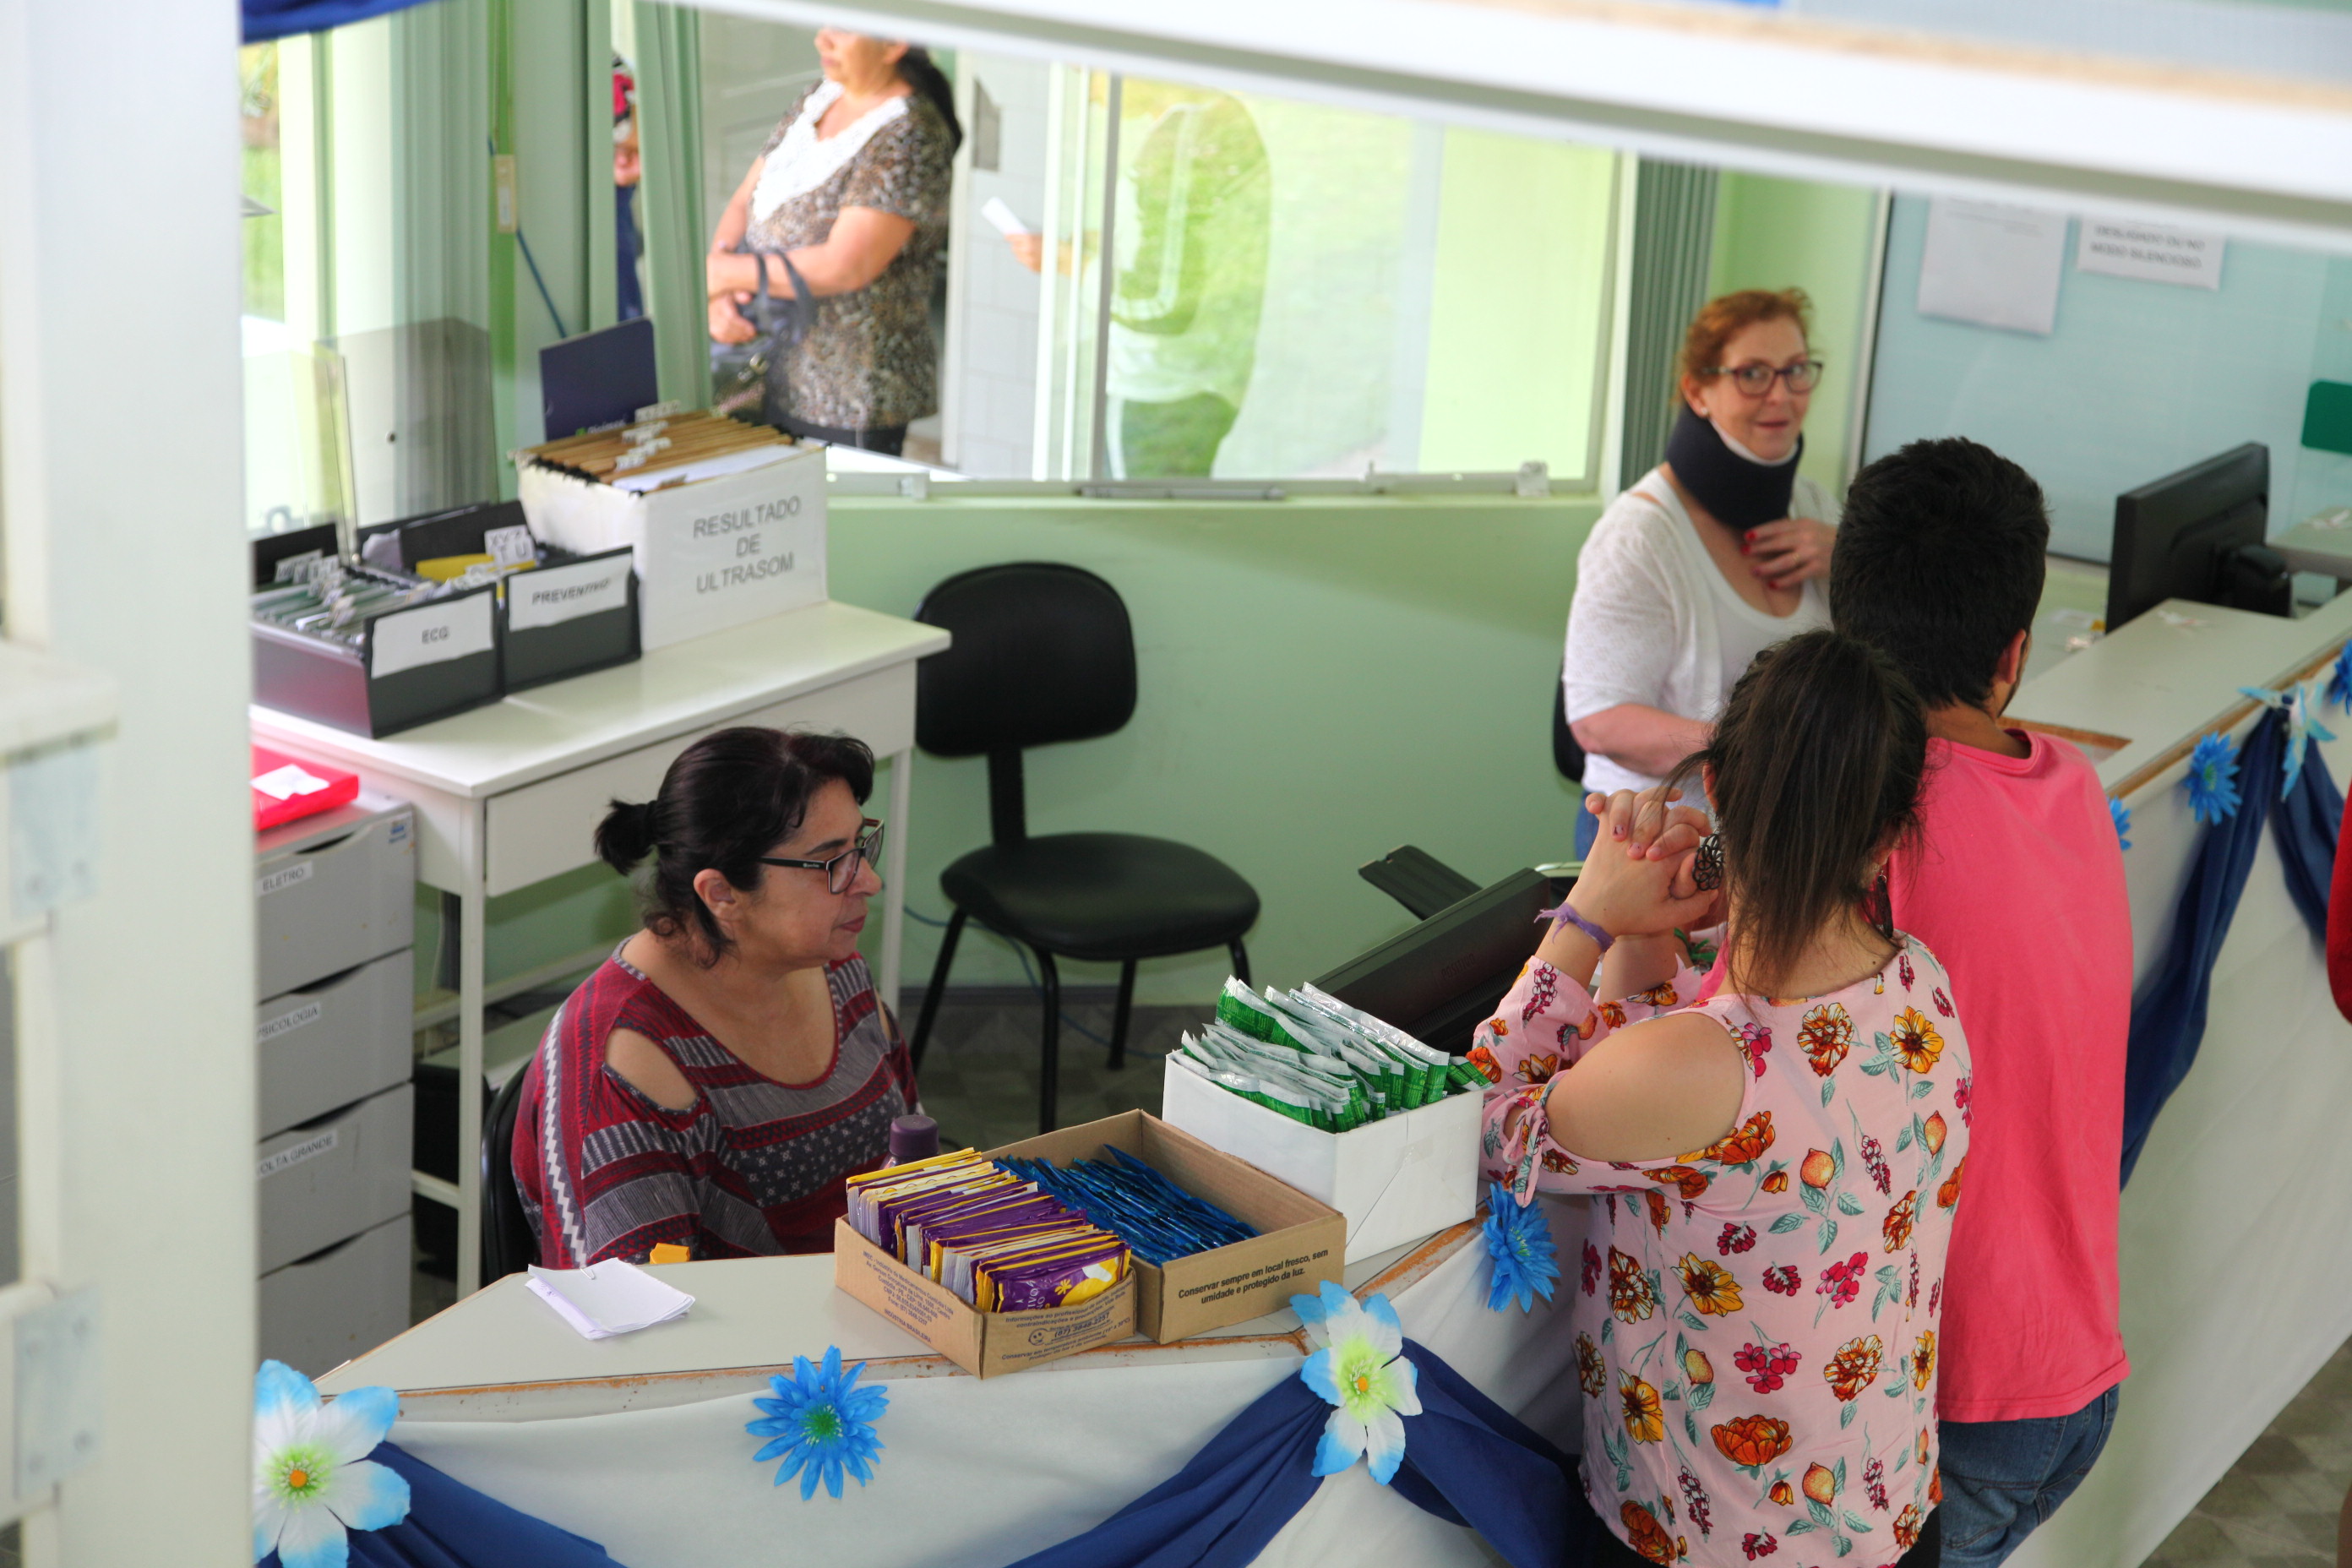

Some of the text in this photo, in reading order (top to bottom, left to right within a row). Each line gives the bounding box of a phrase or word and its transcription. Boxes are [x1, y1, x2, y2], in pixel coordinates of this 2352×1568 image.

[2090, 241, 2128, 258] MODO
[694, 495, 802, 539] RESULTADO
[736, 533, 761, 558] DE
[696, 551, 794, 594] ULTRASOM
[531, 577, 611, 605] PREVENTIVO
[422, 626, 449, 644] ECG
[263, 865, 304, 892] ELETRO
[291, 1134, 333, 1162] GRANDE
[1179, 1250, 1328, 1298] Conservar sempre em local fresco, sem
[1201, 1288, 1234, 1304] umidade
[1243, 1275, 1280, 1293] protegido
[1281, 1270, 1291, 1280] da
[1293, 1267, 1305, 1277] luz.
[1005, 1315, 1044, 1323] Informações
[1054, 1306, 1089, 1319] profissional
[1054, 1327, 1071, 1338] (87)
[1002, 1352, 1032, 1360] Conservar
